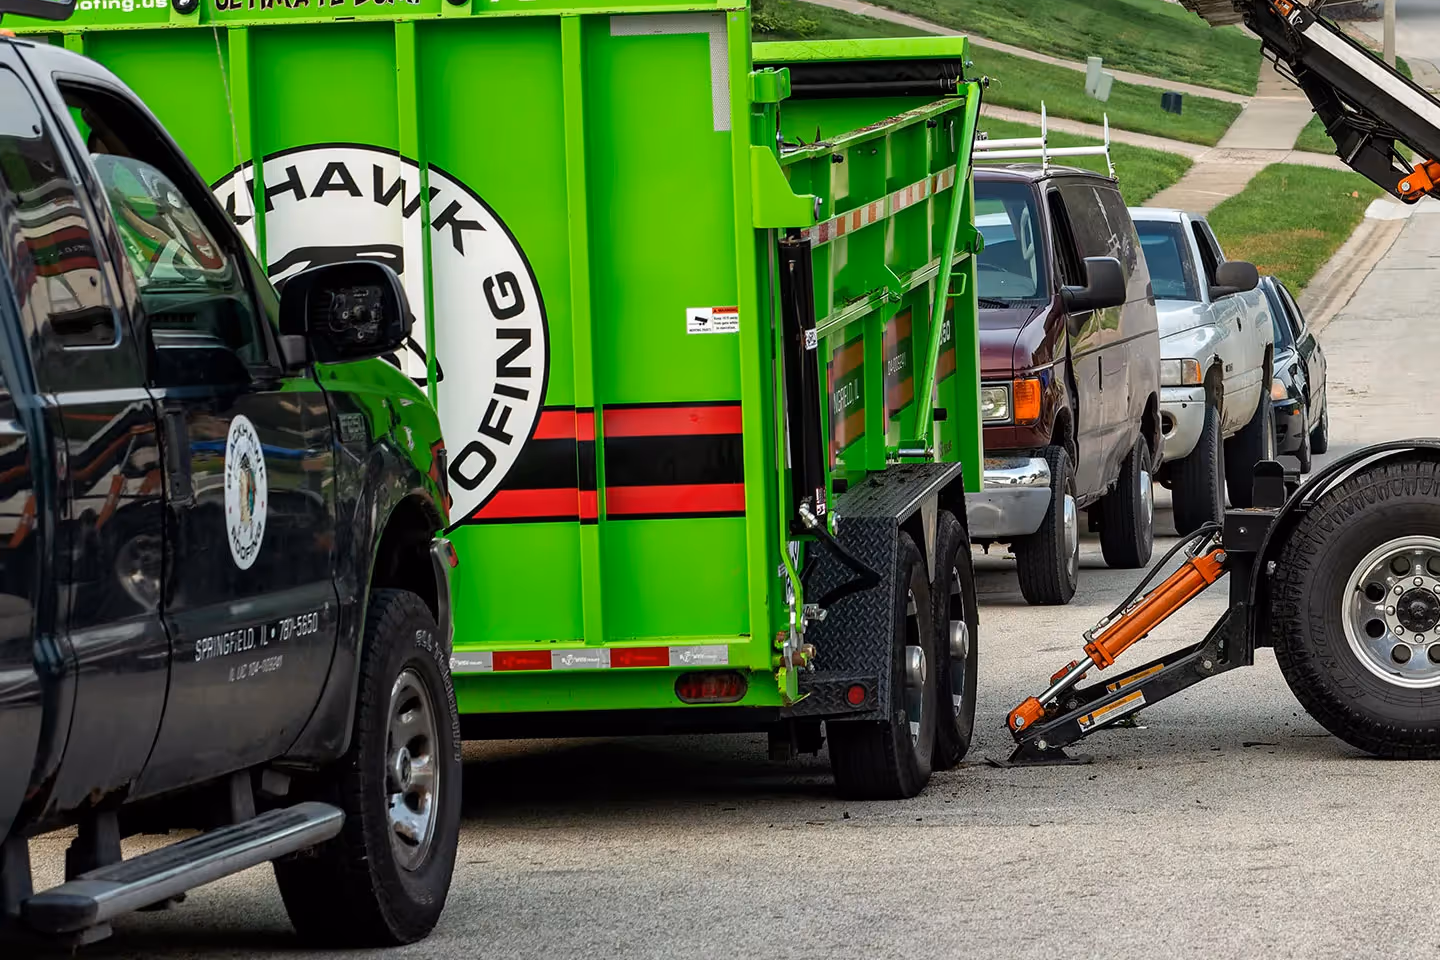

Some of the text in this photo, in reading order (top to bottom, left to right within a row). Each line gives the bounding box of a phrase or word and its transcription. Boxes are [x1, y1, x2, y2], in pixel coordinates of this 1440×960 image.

[448, 271, 532, 491] OFING
[260, 625, 268, 645] IL
[279, 612, 319, 640] 787-5650
